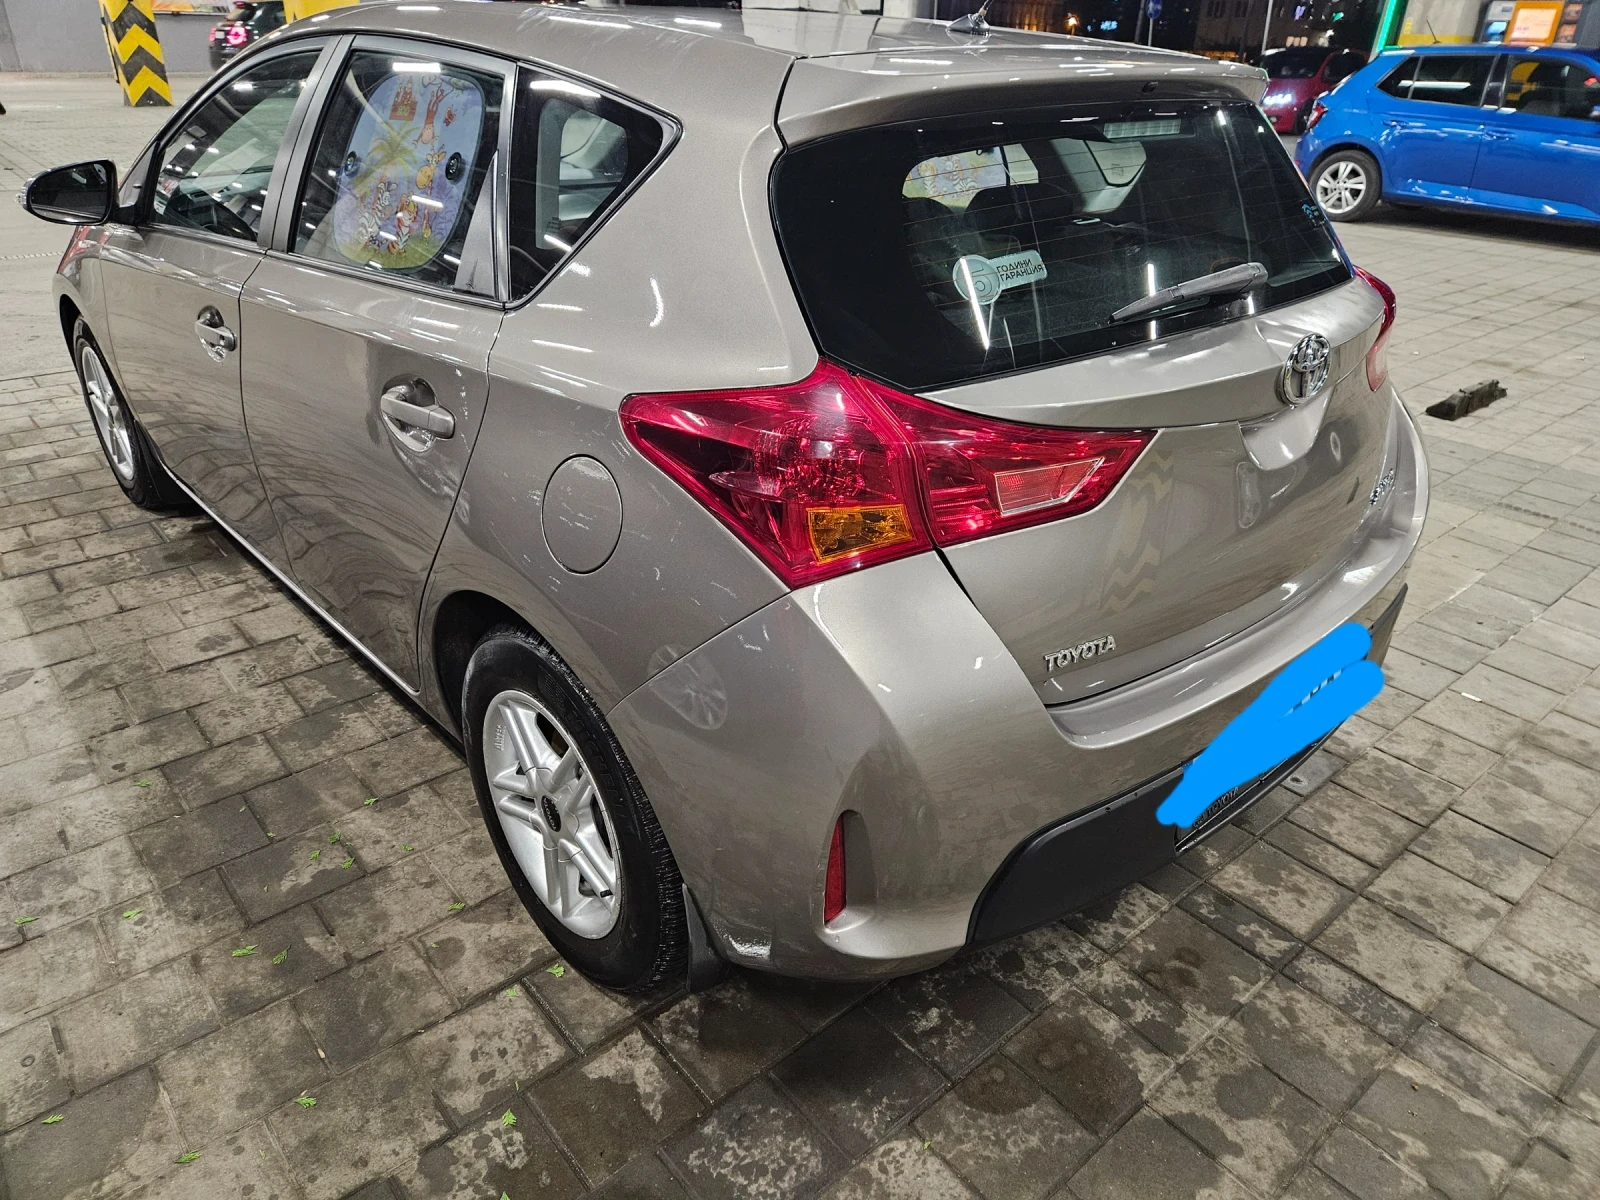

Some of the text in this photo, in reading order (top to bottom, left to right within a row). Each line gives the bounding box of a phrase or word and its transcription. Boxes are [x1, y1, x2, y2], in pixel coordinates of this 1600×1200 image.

[996, 258, 1032, 274] ГОДИНИ
[1000, 264, 1043, 281] ГАРАНЦИЯ
[1043, 634, 1117, 672] TOYOTA
[543, 797, 557, 830] TOYOTA
